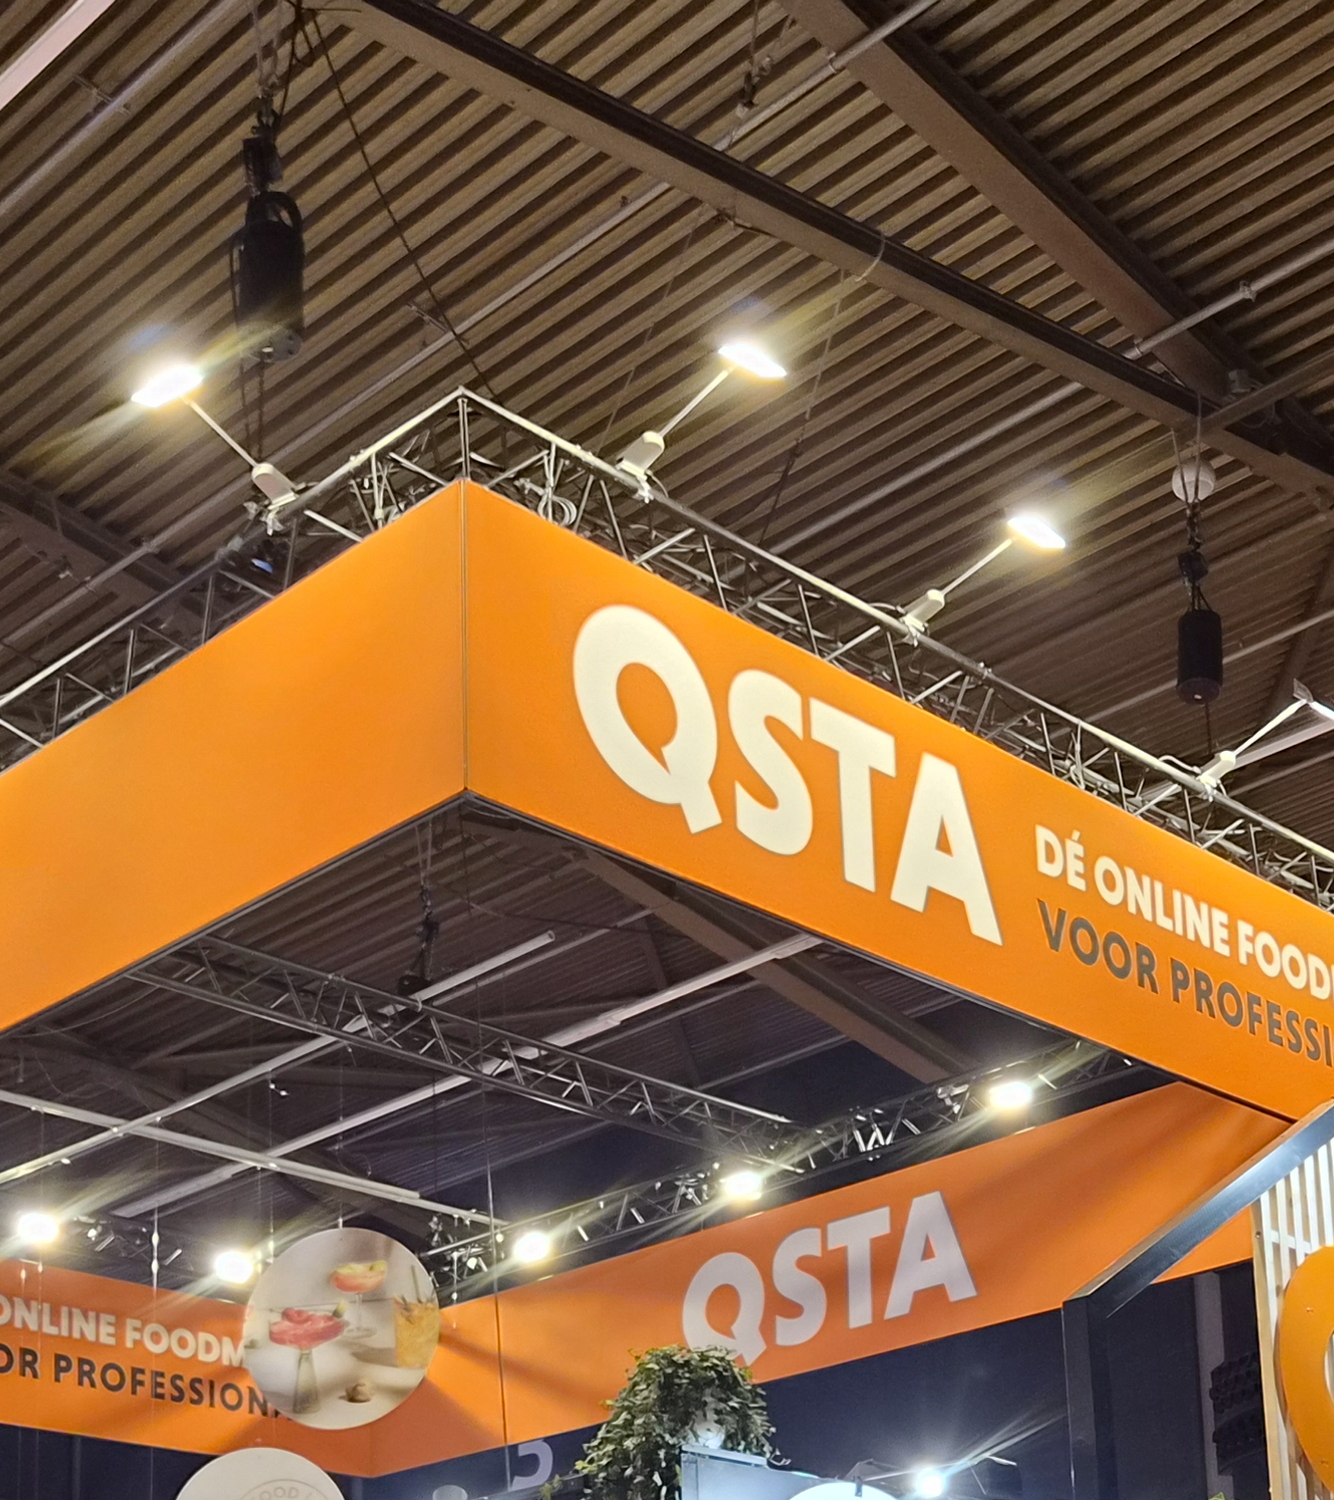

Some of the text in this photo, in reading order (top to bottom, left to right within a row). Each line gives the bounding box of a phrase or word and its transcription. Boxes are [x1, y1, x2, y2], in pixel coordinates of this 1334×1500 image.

[572, 605, 1004, 947] QSTA
[1035, 824, 1087, 893] DÉ
[1093, 857, 1231, 958] ONLINE
[1036, 898, 1159, 995] VOOR
[681, 1190, 979, 1367] QSTA
[54, 1352, 289, 1421] PROFESSION
[124, 1319, 246, 1368] FOODM
